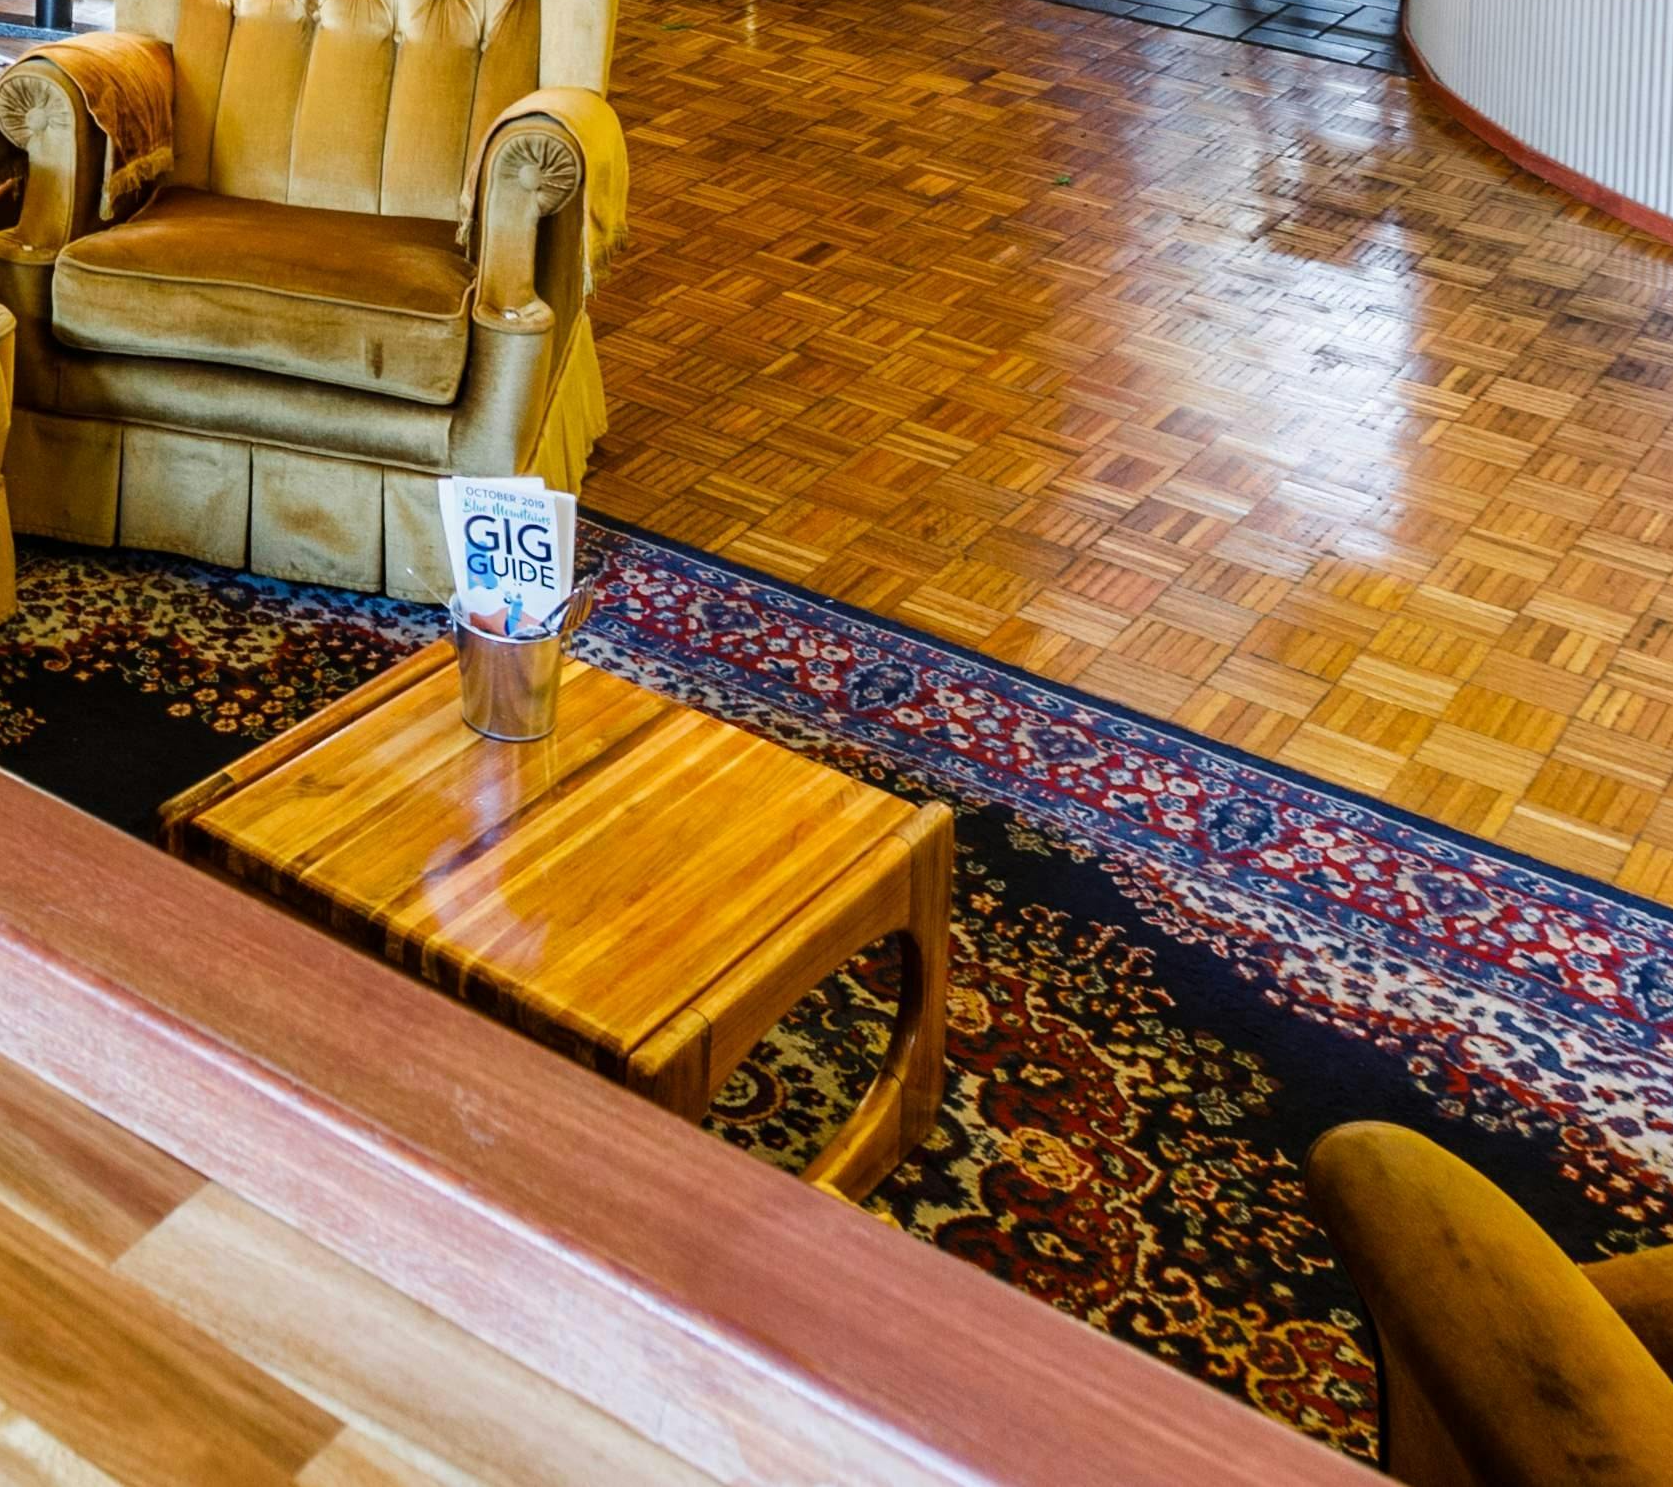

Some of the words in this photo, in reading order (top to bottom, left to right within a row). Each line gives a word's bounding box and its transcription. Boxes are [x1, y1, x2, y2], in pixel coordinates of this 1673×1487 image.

[462, 497, 487, 513] Blue
[493, 503, 550, 525] Mountains
[466, 486, 516, 503] OCTOBER
[522, 496, 545, 509] 2019
[464, 515, 552, 562] GIG
[467, 553, 554, 590] GUIDE
